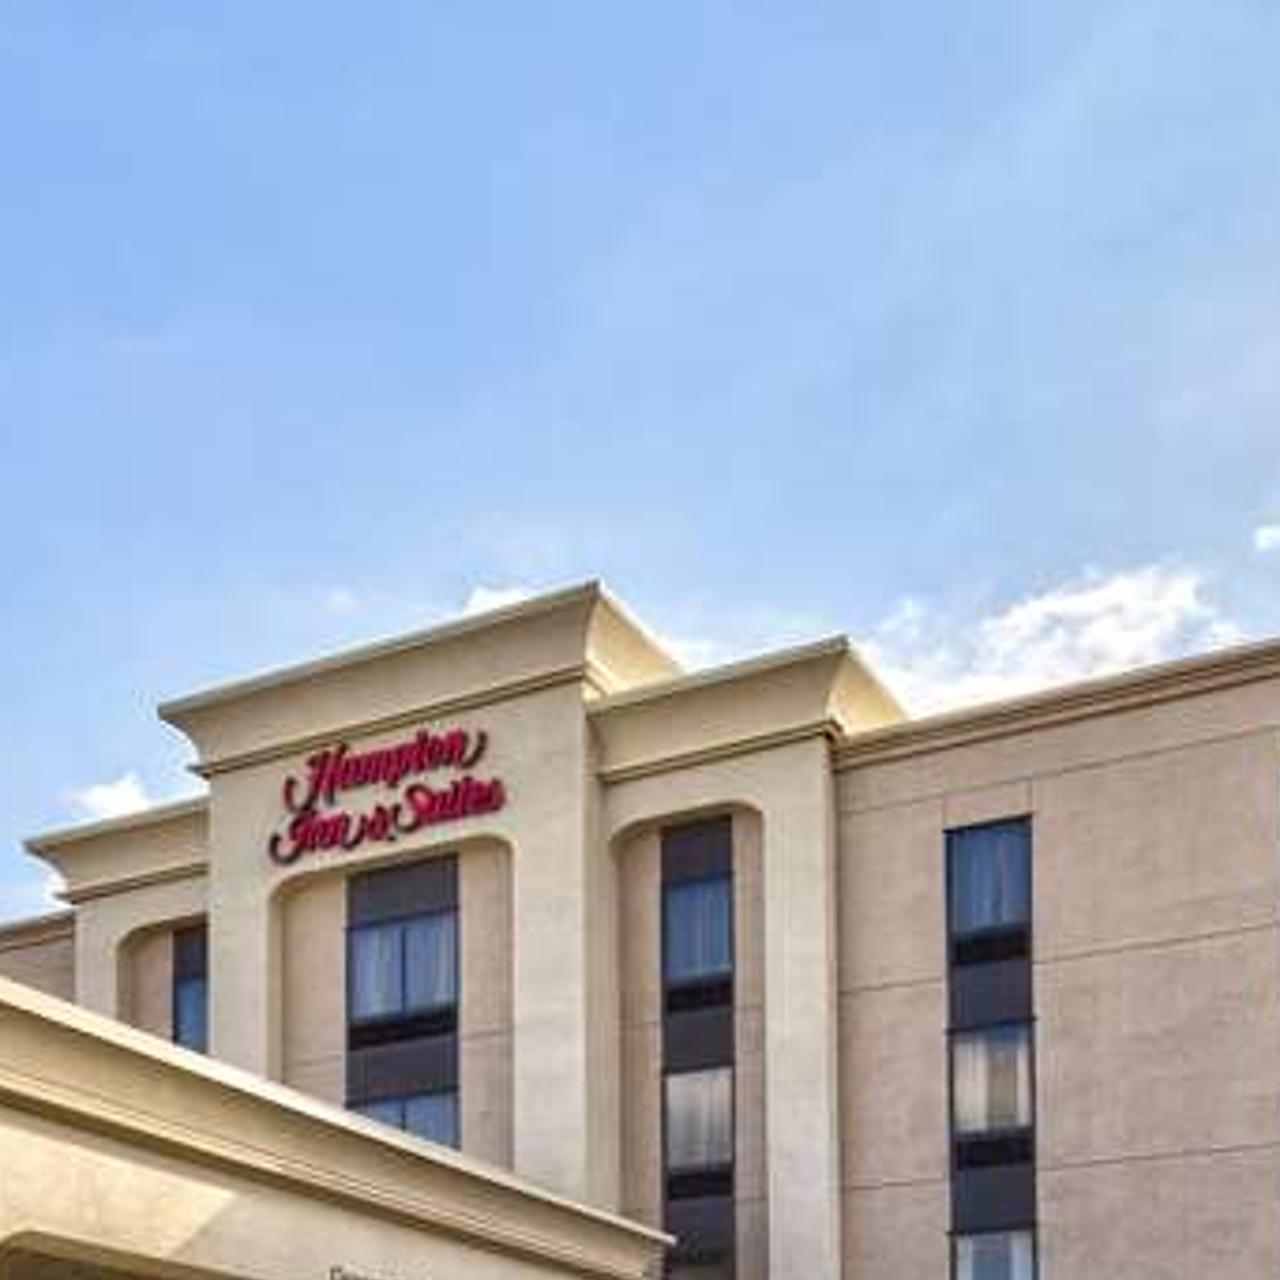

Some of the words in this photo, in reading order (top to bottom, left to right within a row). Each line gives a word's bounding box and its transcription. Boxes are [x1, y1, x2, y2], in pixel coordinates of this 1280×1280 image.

[284, 729, 487, 812] Hampton
[269, 810, 366, 864] Inn
[392, 776, 505, 833] Suites
